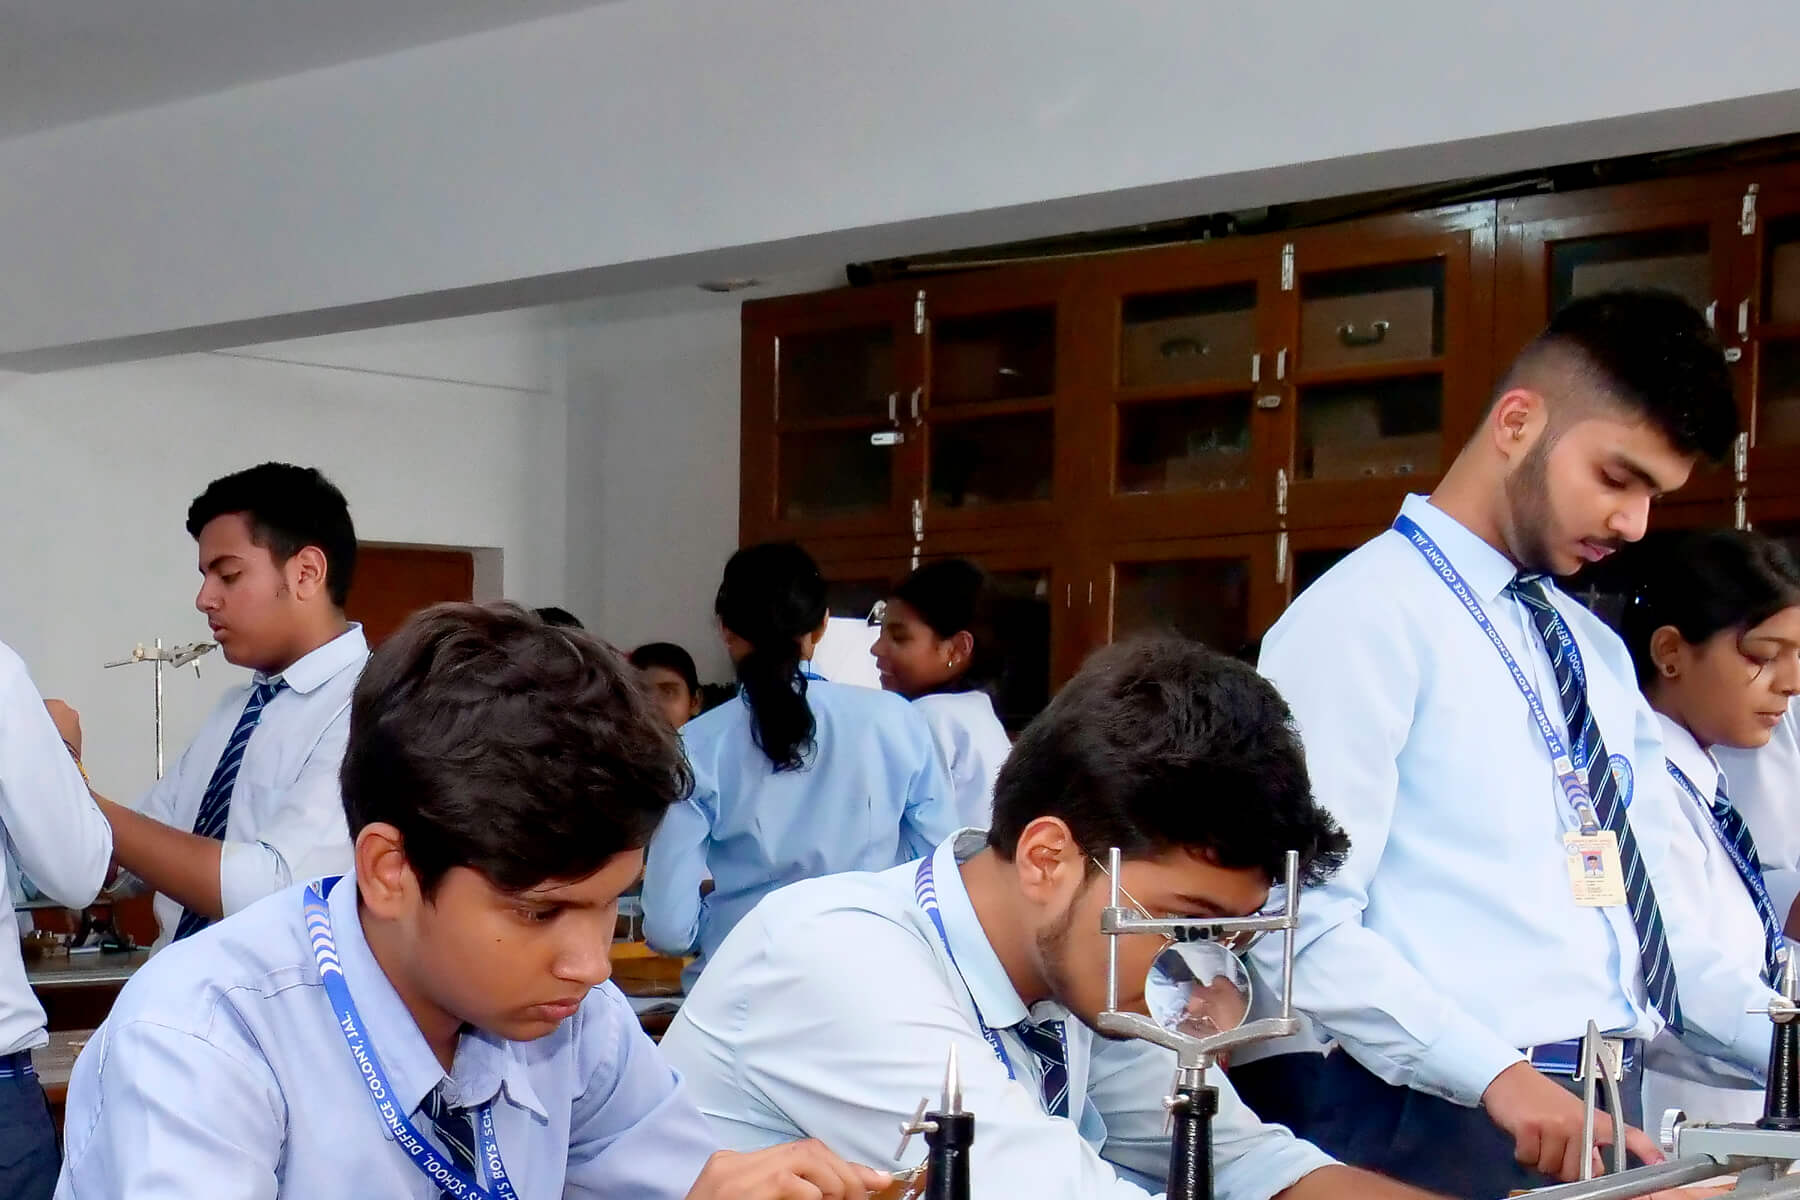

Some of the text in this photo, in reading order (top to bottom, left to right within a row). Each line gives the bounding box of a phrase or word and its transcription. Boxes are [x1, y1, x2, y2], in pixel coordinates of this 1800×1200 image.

[1424, 545, 1457, 583] COLONY,
[341, 1010, 358, 1039] JAL.
[351, 1040, 385, 1099] COLONY,
[380, 1100, 424, 1156] DEFENCE
[483, 1108, 494, 1136] SCH
[423, 1153, 467, 1195] SCHOOL,
[485, 1141, 505, 1179] BOYS'
